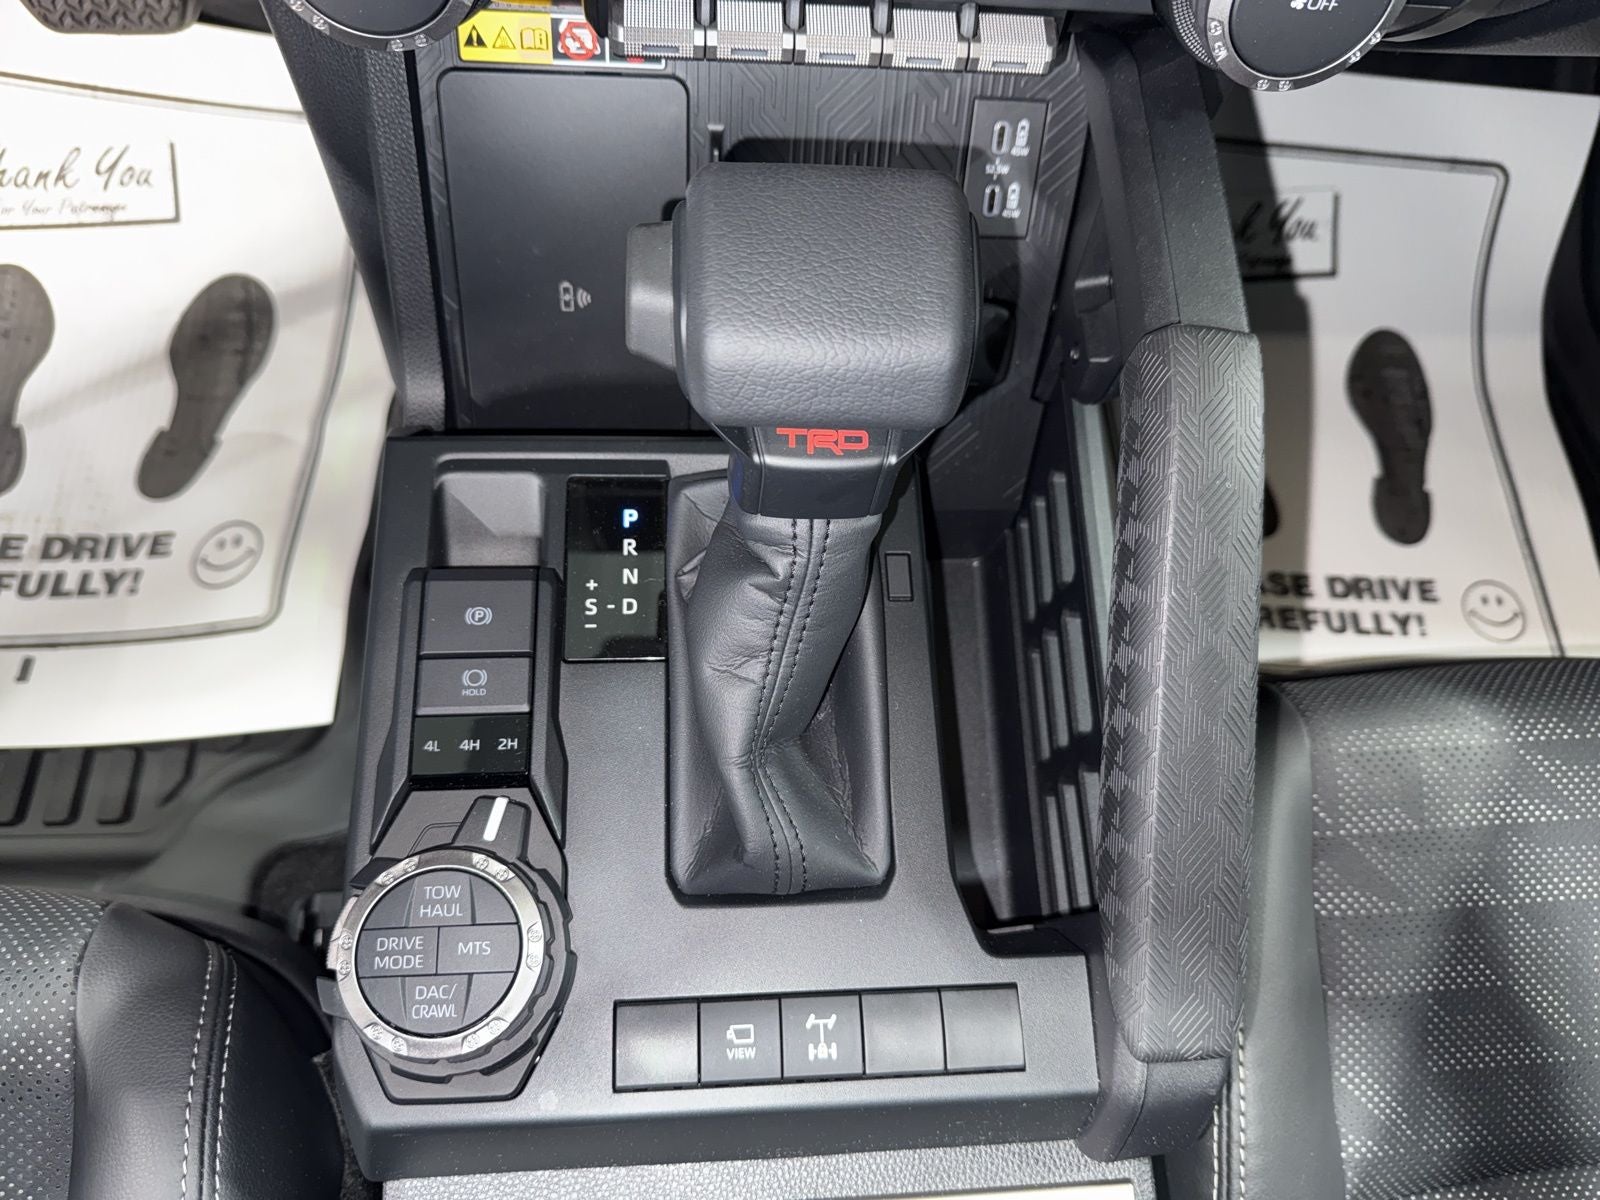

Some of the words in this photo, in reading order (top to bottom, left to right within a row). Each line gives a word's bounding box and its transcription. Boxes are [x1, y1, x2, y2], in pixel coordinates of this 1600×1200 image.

[95, 144, 153, 191] You
[776, 427, 869, 456] TRD
[622, 508, 639, 529] P
[40, 532, 175, 562] DRIVE
[622, 538, 638, 556] R
[622, 568, 639, 585] N
[1326, 575, 1440, 603] DRIVE
[584, 598, 598, 616] S
[621, 598, 638, 615] D
[462, 688, 486, 696] HOLD
[424, 740, 440, 752] 4L
[459, 739, 480, 751] 4H
[498, 738, 518, 750] 2H
[423, 885, 461, 900] TOW
[419, 904, 463, 918] HAUL
[376, 936, 424, 951] DRIVE
[457, 941, 491, 956] MTS
[374, 955, 424, 970] MODE
[415, 984, 457, 1000] DAC/
[412, 1004, 458, 1019] CRAWL
[726, 1048, 756, 1059] VIEW
